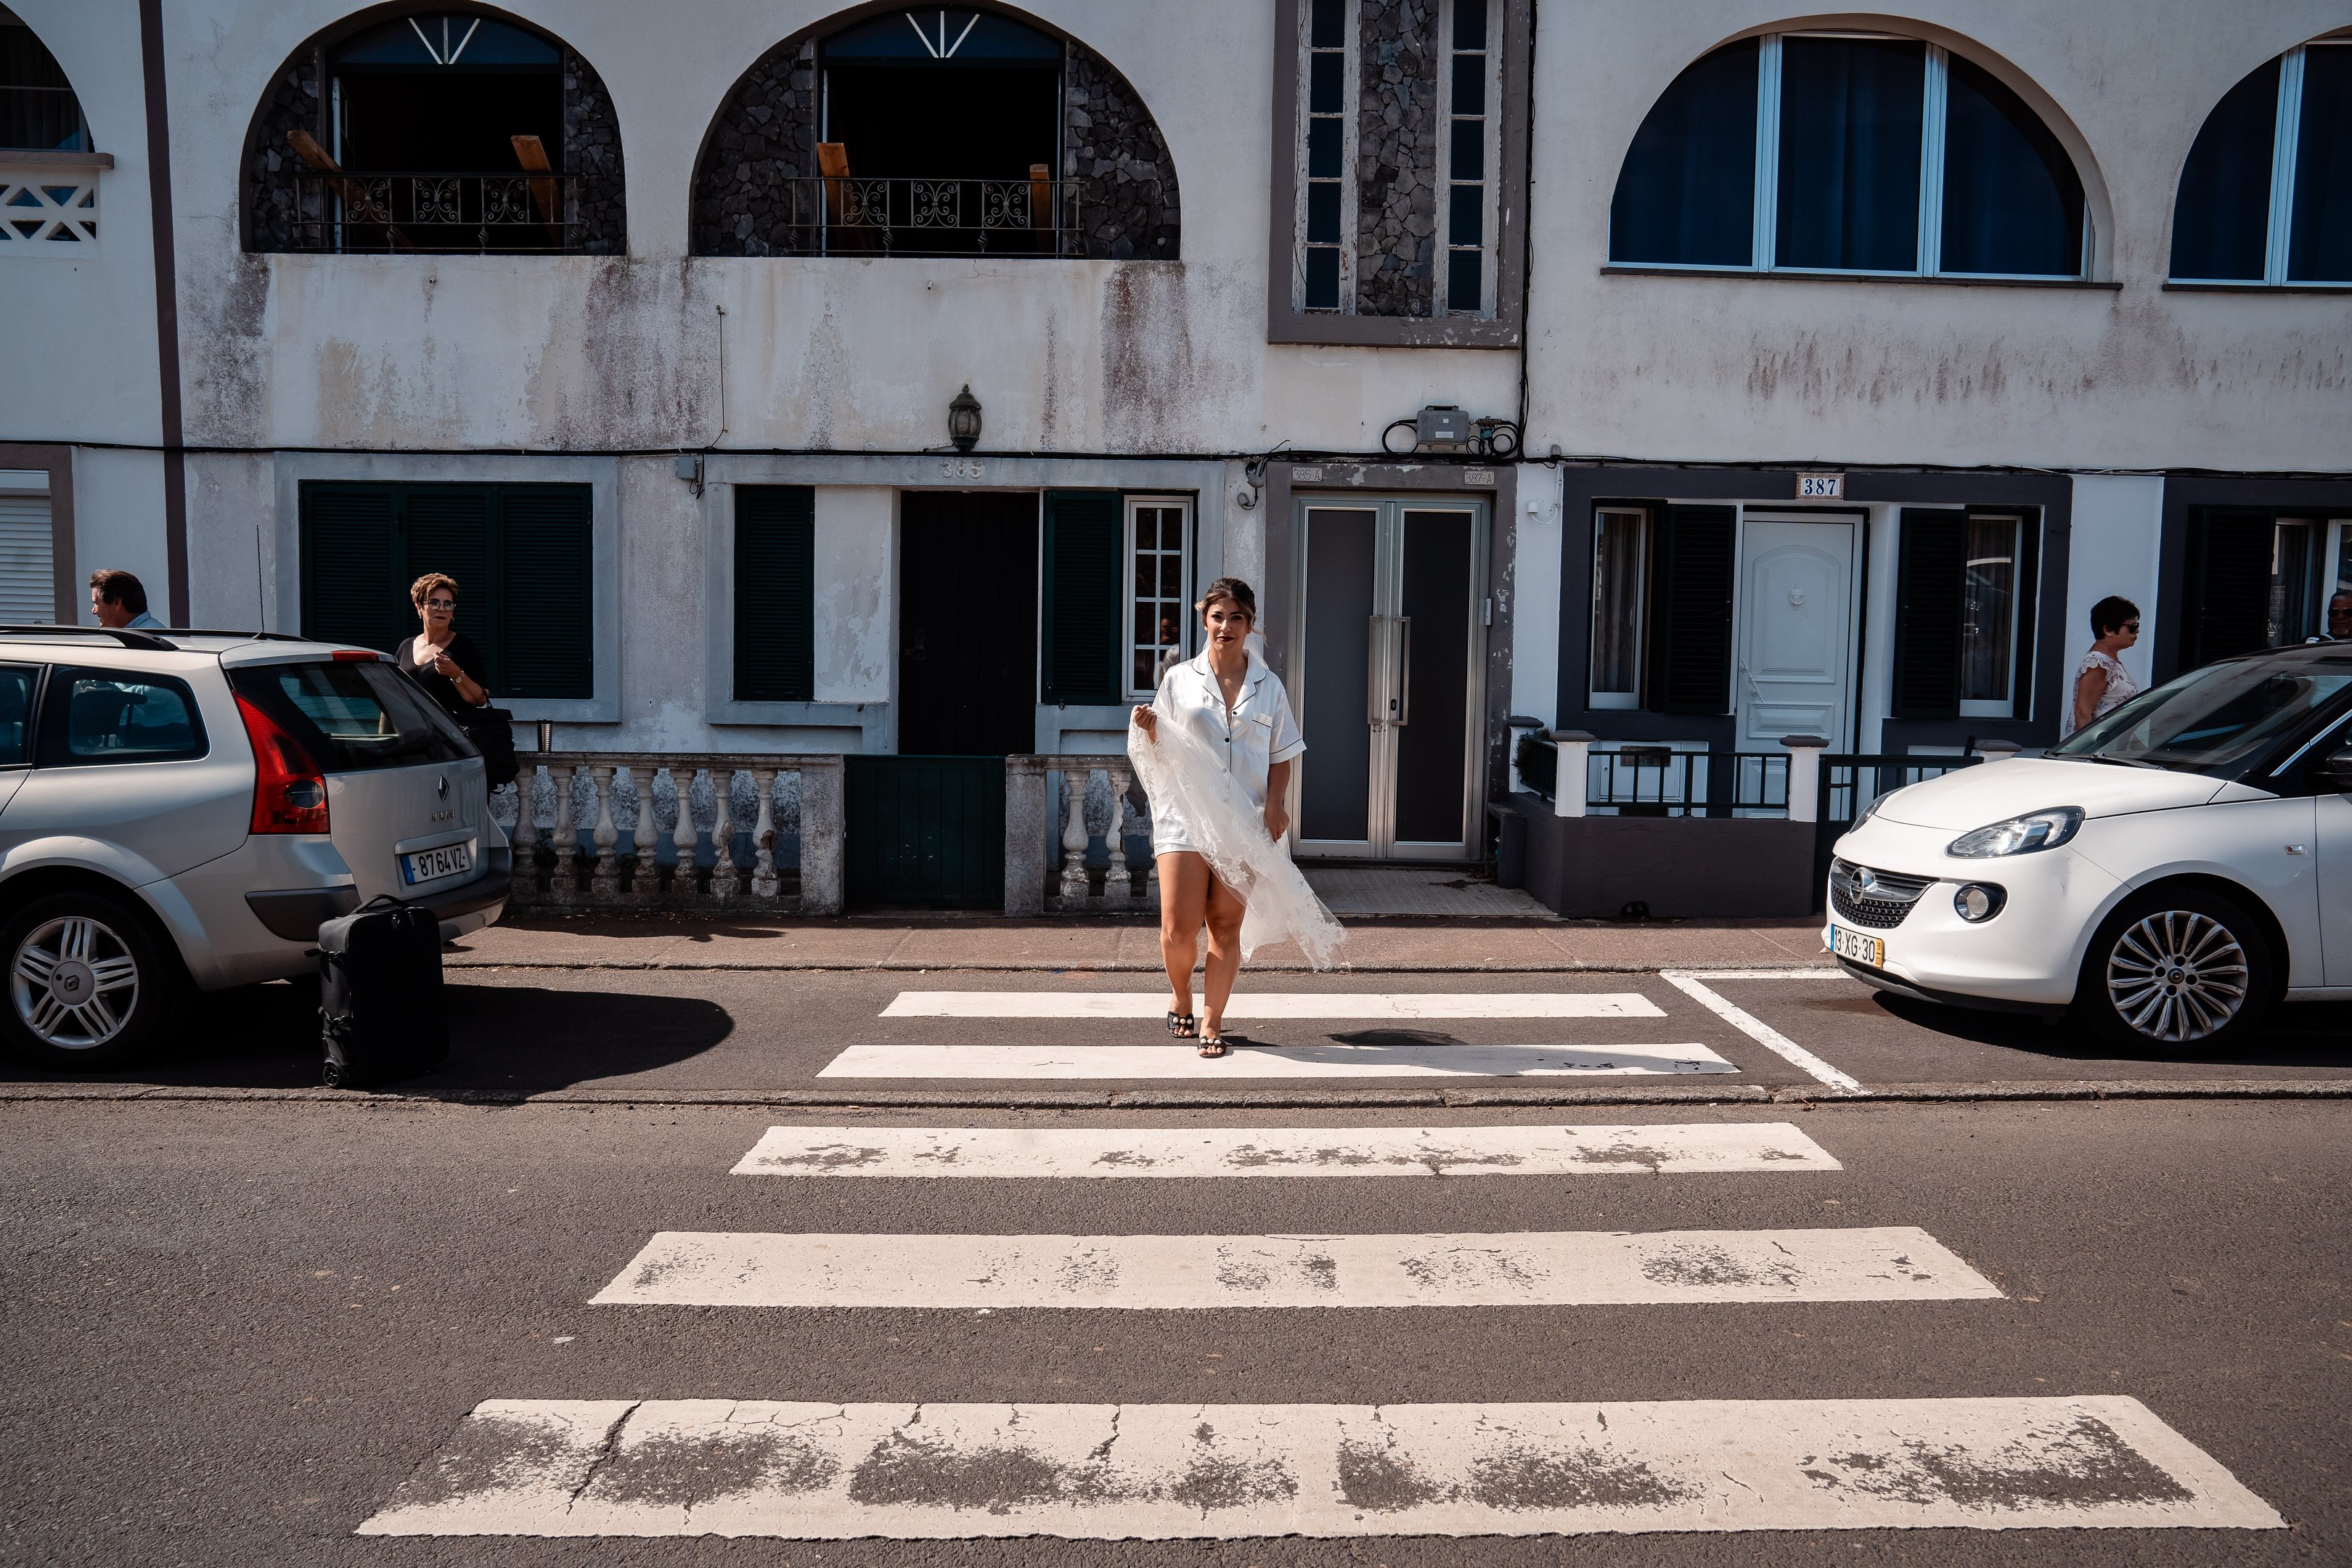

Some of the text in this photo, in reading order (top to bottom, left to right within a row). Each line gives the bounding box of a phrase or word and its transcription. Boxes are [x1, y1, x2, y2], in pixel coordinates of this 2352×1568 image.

[942, 461, 982, 479] 385
[1293, 468, 1320, 481] 385-A
[1466, 473, 1493, 484] 387-A
[1804, 478, 1837, 495] 387
